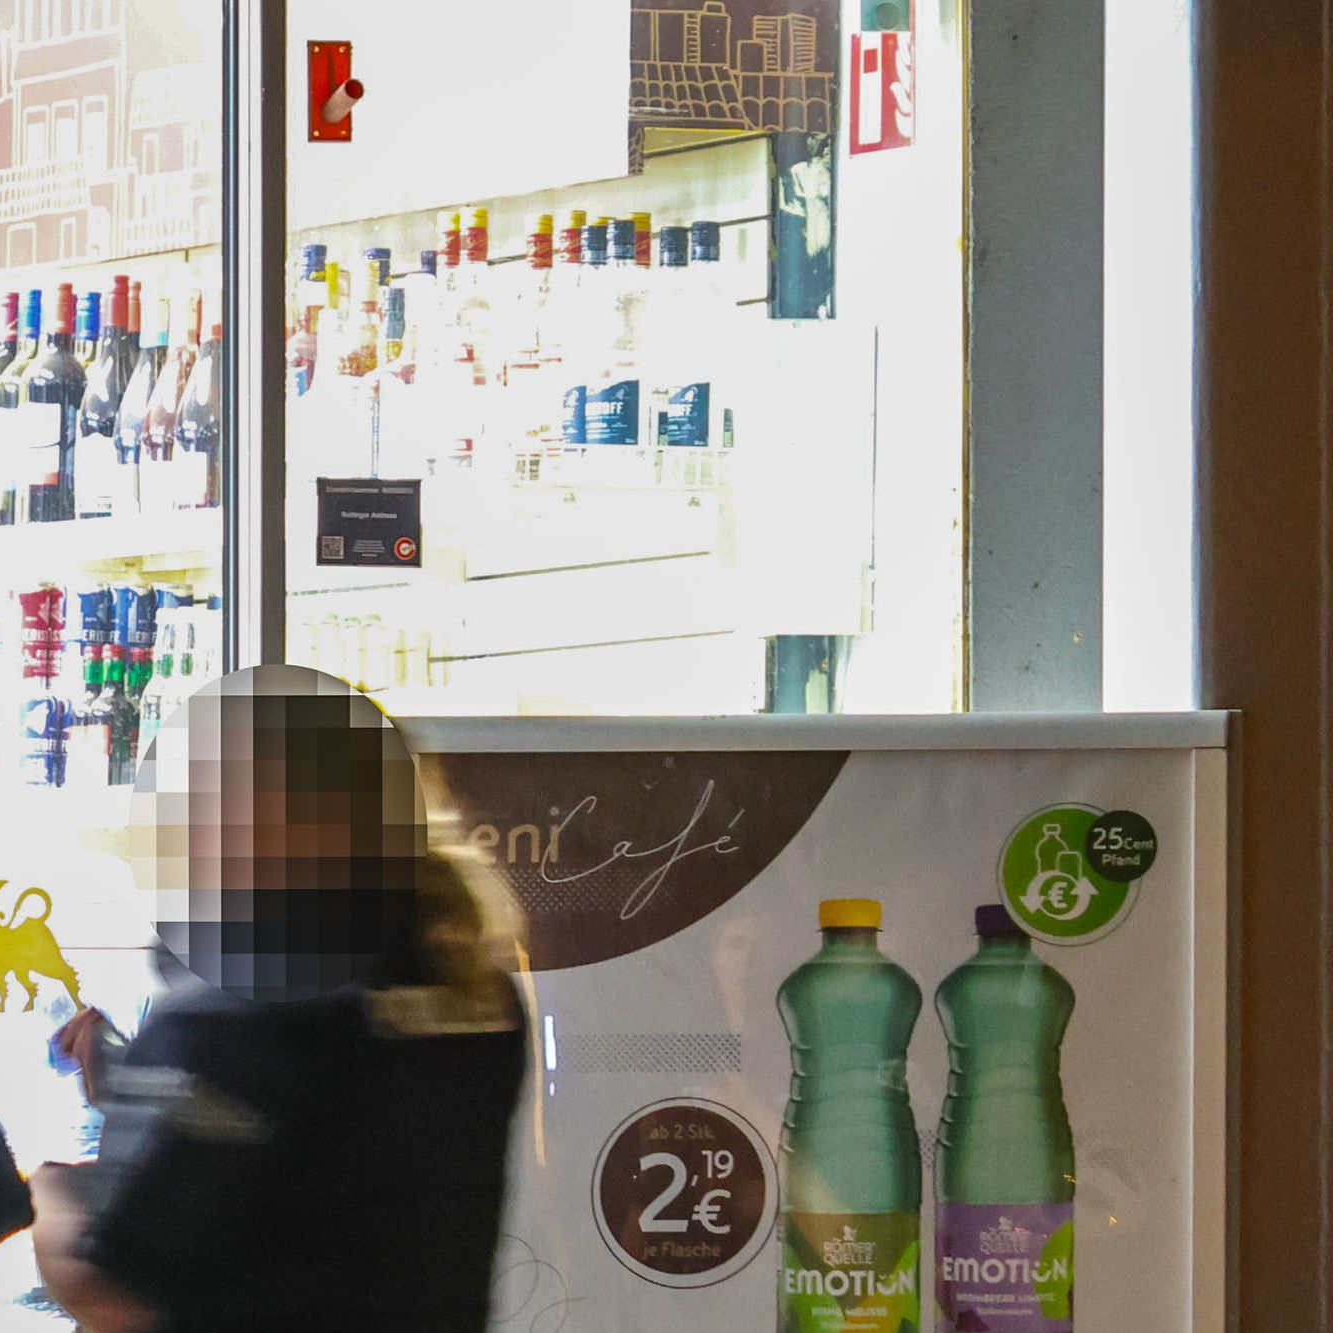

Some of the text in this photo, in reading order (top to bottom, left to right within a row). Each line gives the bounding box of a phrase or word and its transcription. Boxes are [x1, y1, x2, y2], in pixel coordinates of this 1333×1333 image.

[541, 780, 745, 920] Café
[1102, 853, 1141, 866] Pfand
[649, 1124, 670, 1140] ab
[673, 1124, 683, 1139] 2
[692, 1189, 732, 1234] €
[643, 1242, 721, 1259] je Flasche
